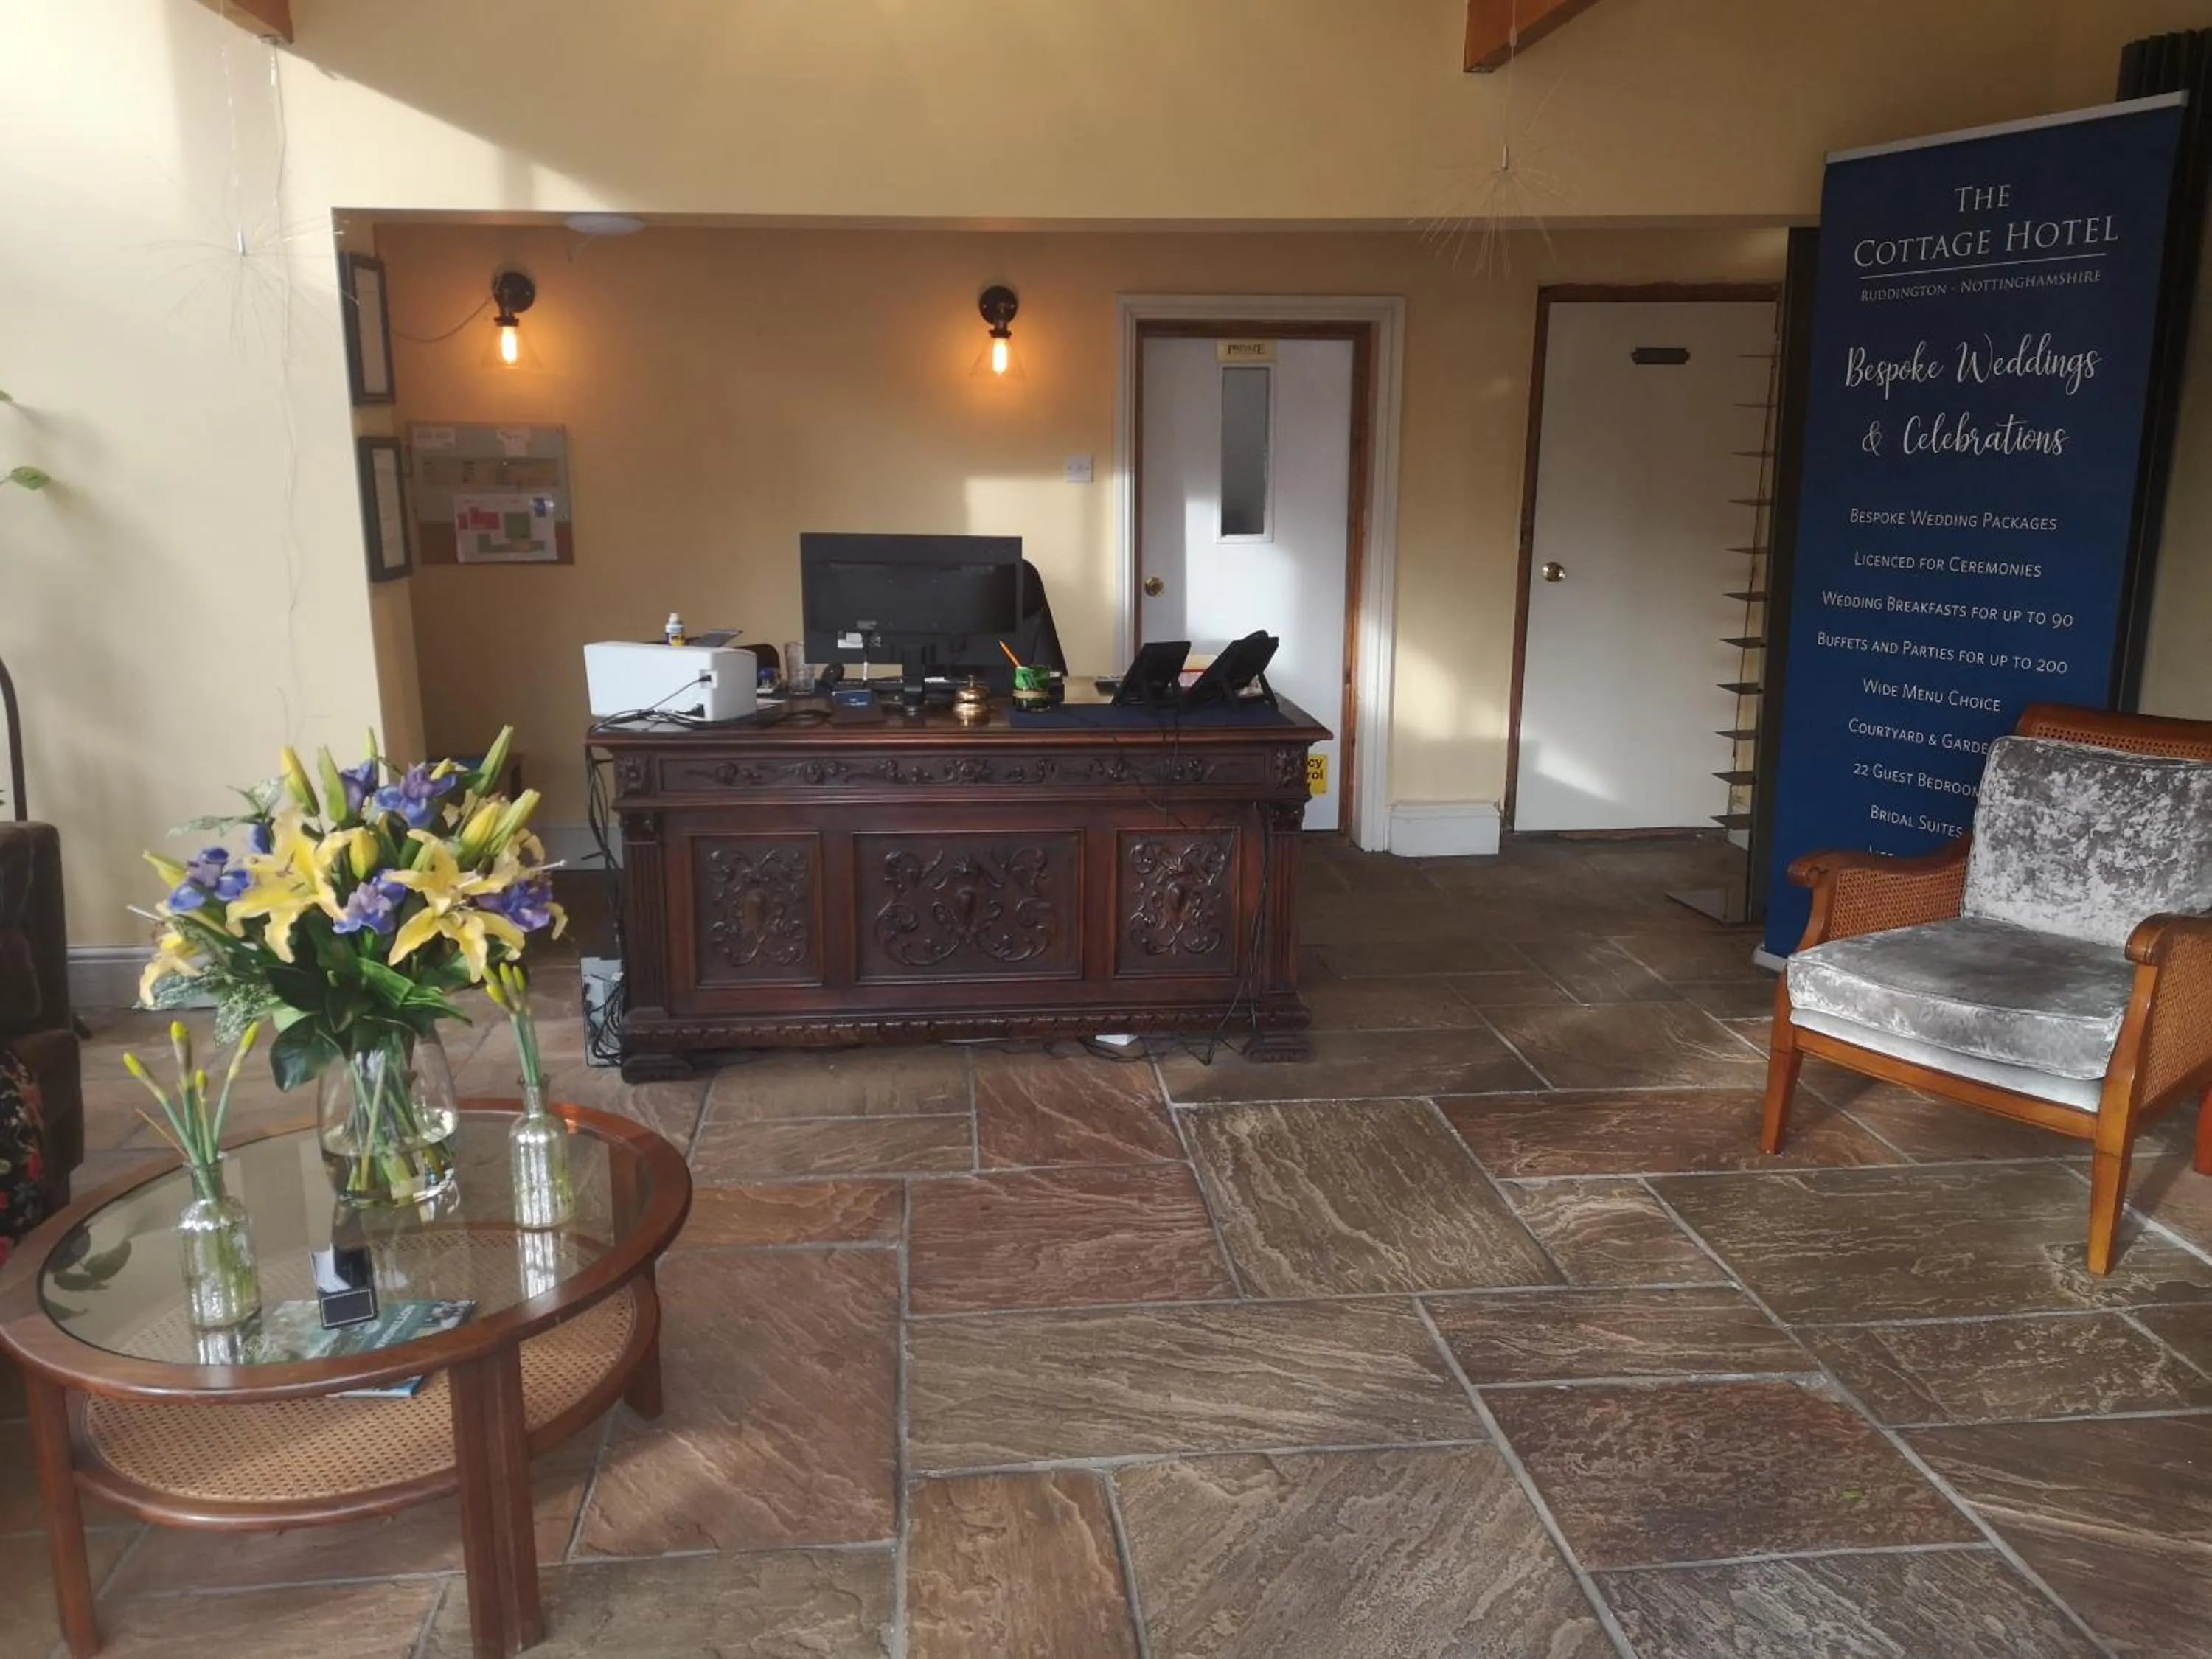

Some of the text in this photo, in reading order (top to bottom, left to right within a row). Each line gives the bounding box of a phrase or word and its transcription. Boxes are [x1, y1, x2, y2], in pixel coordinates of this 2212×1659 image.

[1955, 185, 2011, 212] THE
[1854, 215, 2118, 268] COTTAGE HOTEL
[1861, 284, 1947, 302] RUDDINGTON
[1961, 269, 2101, 294] NOTTINGHAMSHIRE
[1846, 333, 2102, 400] Bespoke Weddings
[1862, 411, 2070, 456] & Celebrations
[1850, 508, 2057, 531] BESPOKE WEDDING PACKAGES
[1854, 551, 2042, 577] LICENCED FOR CEREMONIES
[1822, 591, 2073, 628] WEDDING BREAKFASTS FOR UP TO 90
[1818, 631, 2068, 674] BUFFETS AND PARTIES FOR UP TO 200
[1863, 678, 2001, 712] WIDE MENU CHOICE
[1848, 717, 1989, 755] COURTYARD & GARDE
[1853, 763, 1979, 797] 22 GUEST BEDROO
[1871, 804, 1963, 838] BRIDAL SUITES
